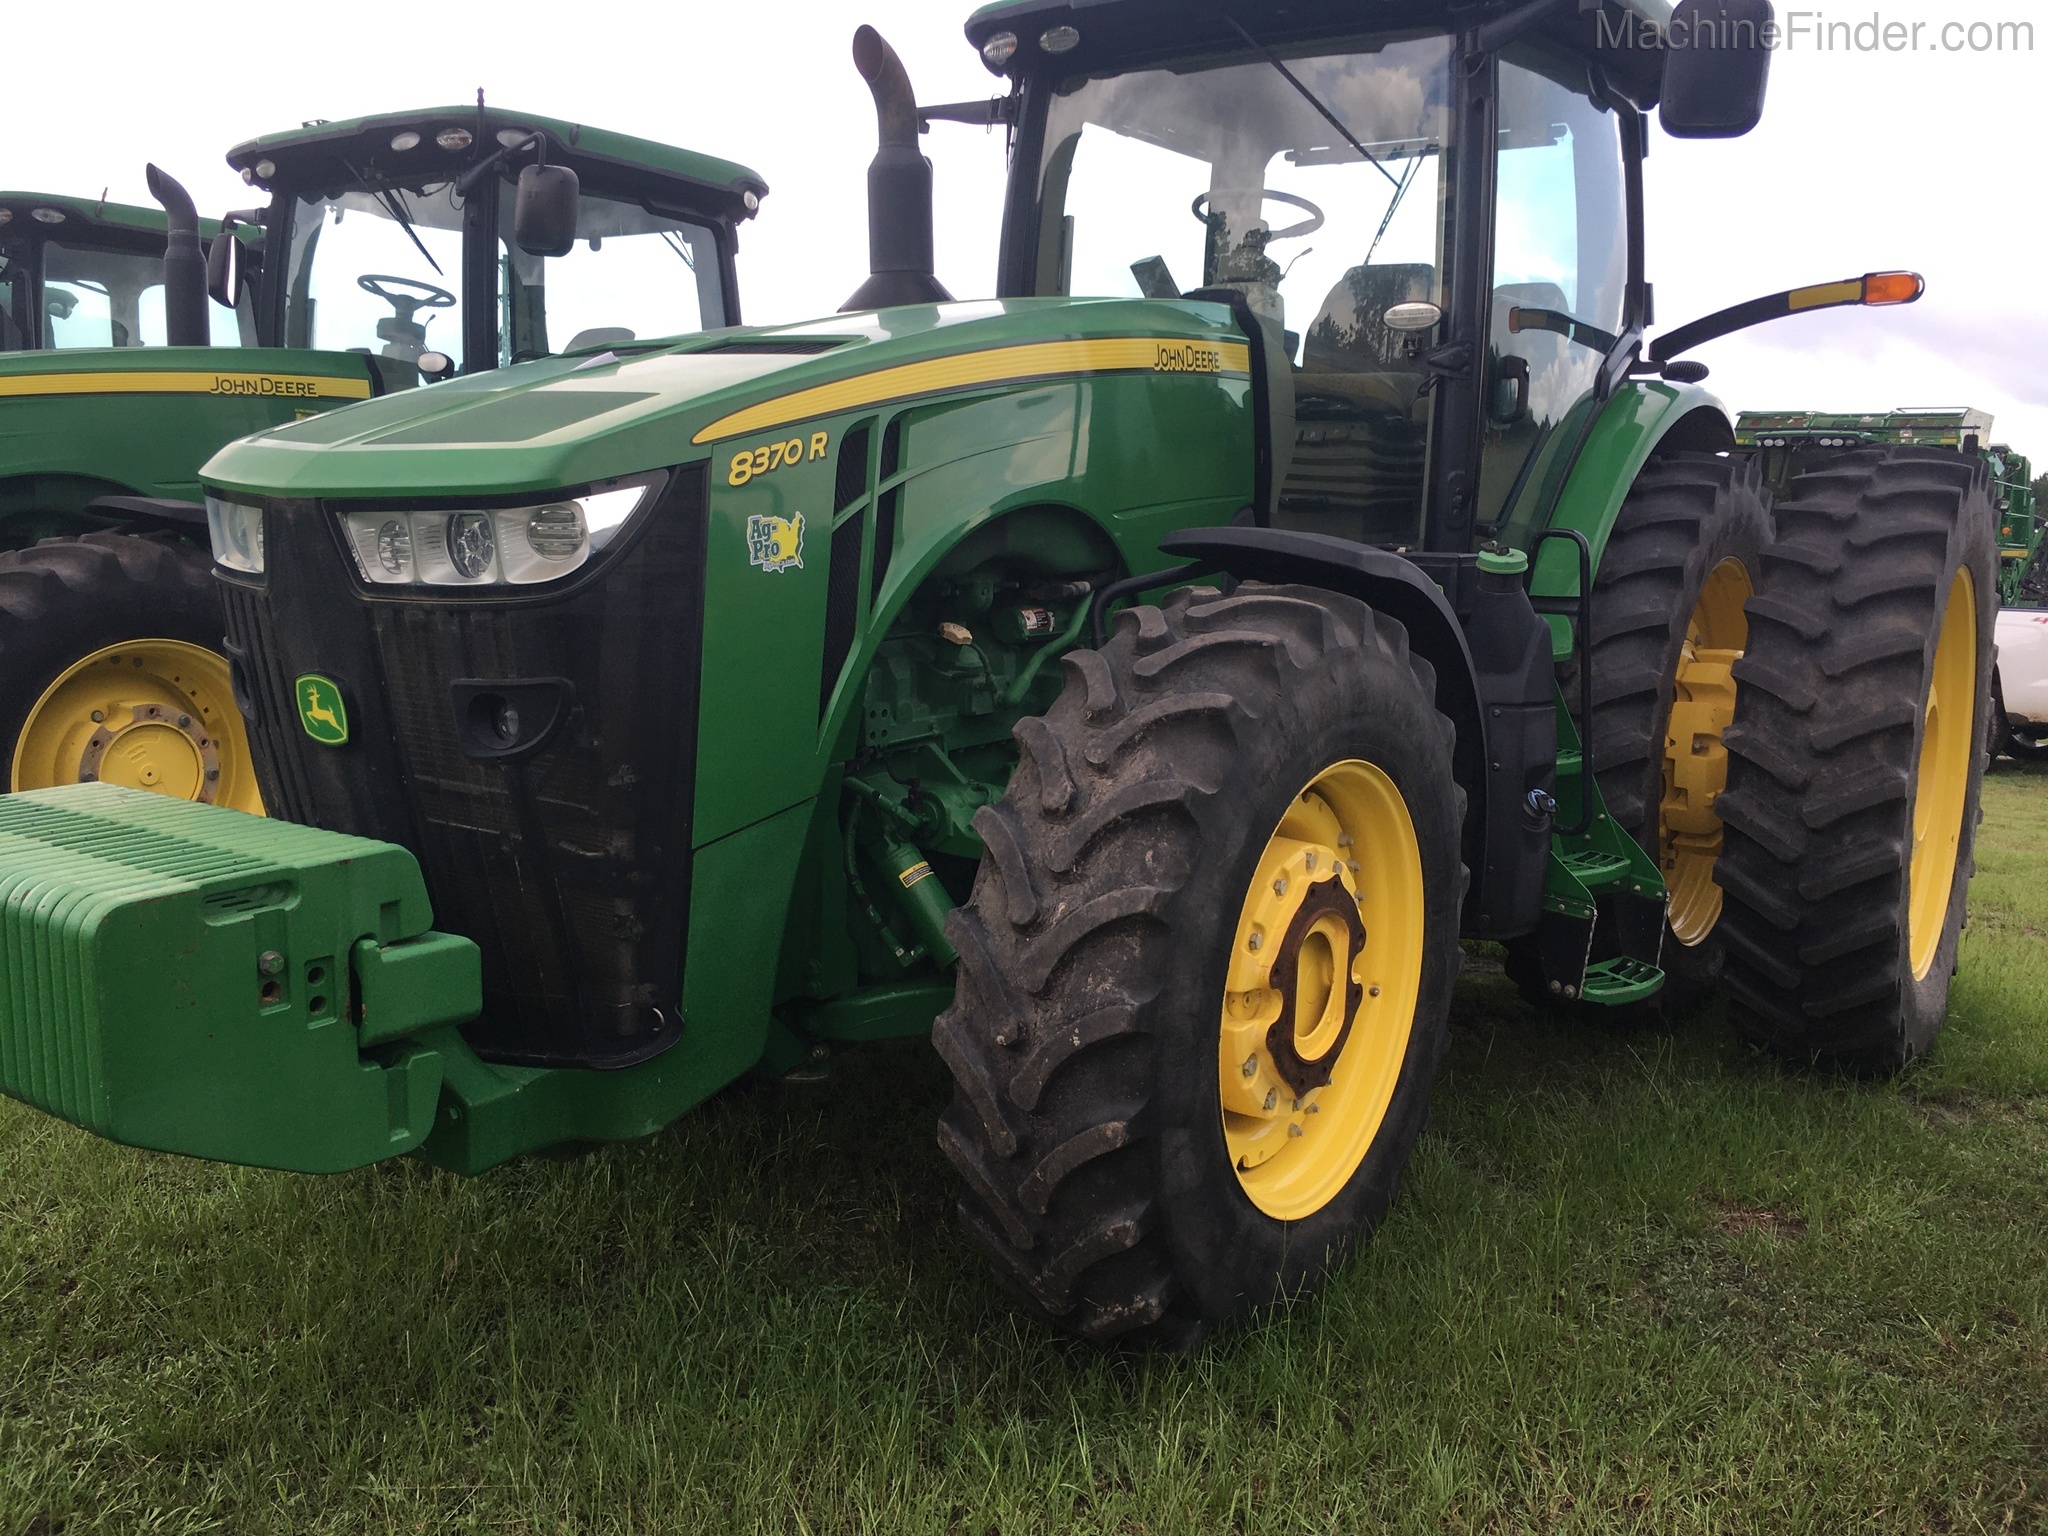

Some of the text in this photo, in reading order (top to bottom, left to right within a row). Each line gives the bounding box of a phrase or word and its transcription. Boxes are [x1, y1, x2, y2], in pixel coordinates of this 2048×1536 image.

[1154, 343, 1220, 370] JOHN DEERE
[210, 376, 317, 395] JOHN DEERE
[728, 431, 828, 487] 8370 R
[751, 519, 777, 543] Ag-
[753, 540, 780, 561] Pro
